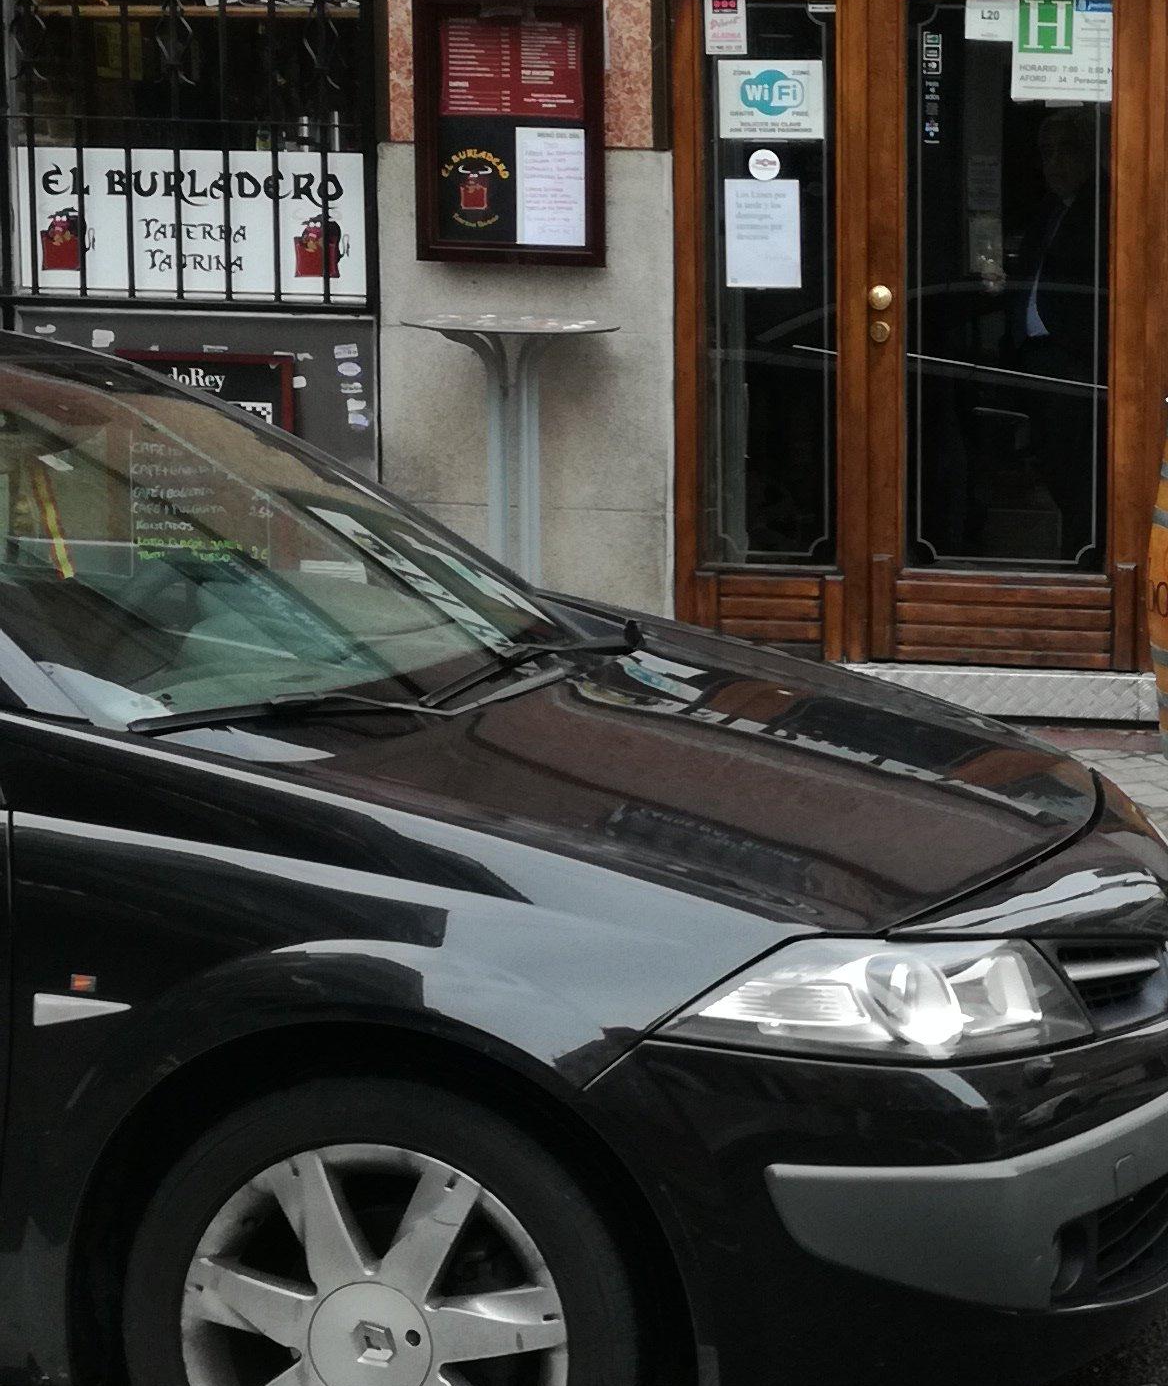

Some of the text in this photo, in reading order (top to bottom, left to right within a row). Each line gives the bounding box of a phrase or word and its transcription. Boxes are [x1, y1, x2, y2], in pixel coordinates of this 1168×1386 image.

[42, 163, 344, 210] EL BURLADERO
[167, 366, 226, 393] doRey
